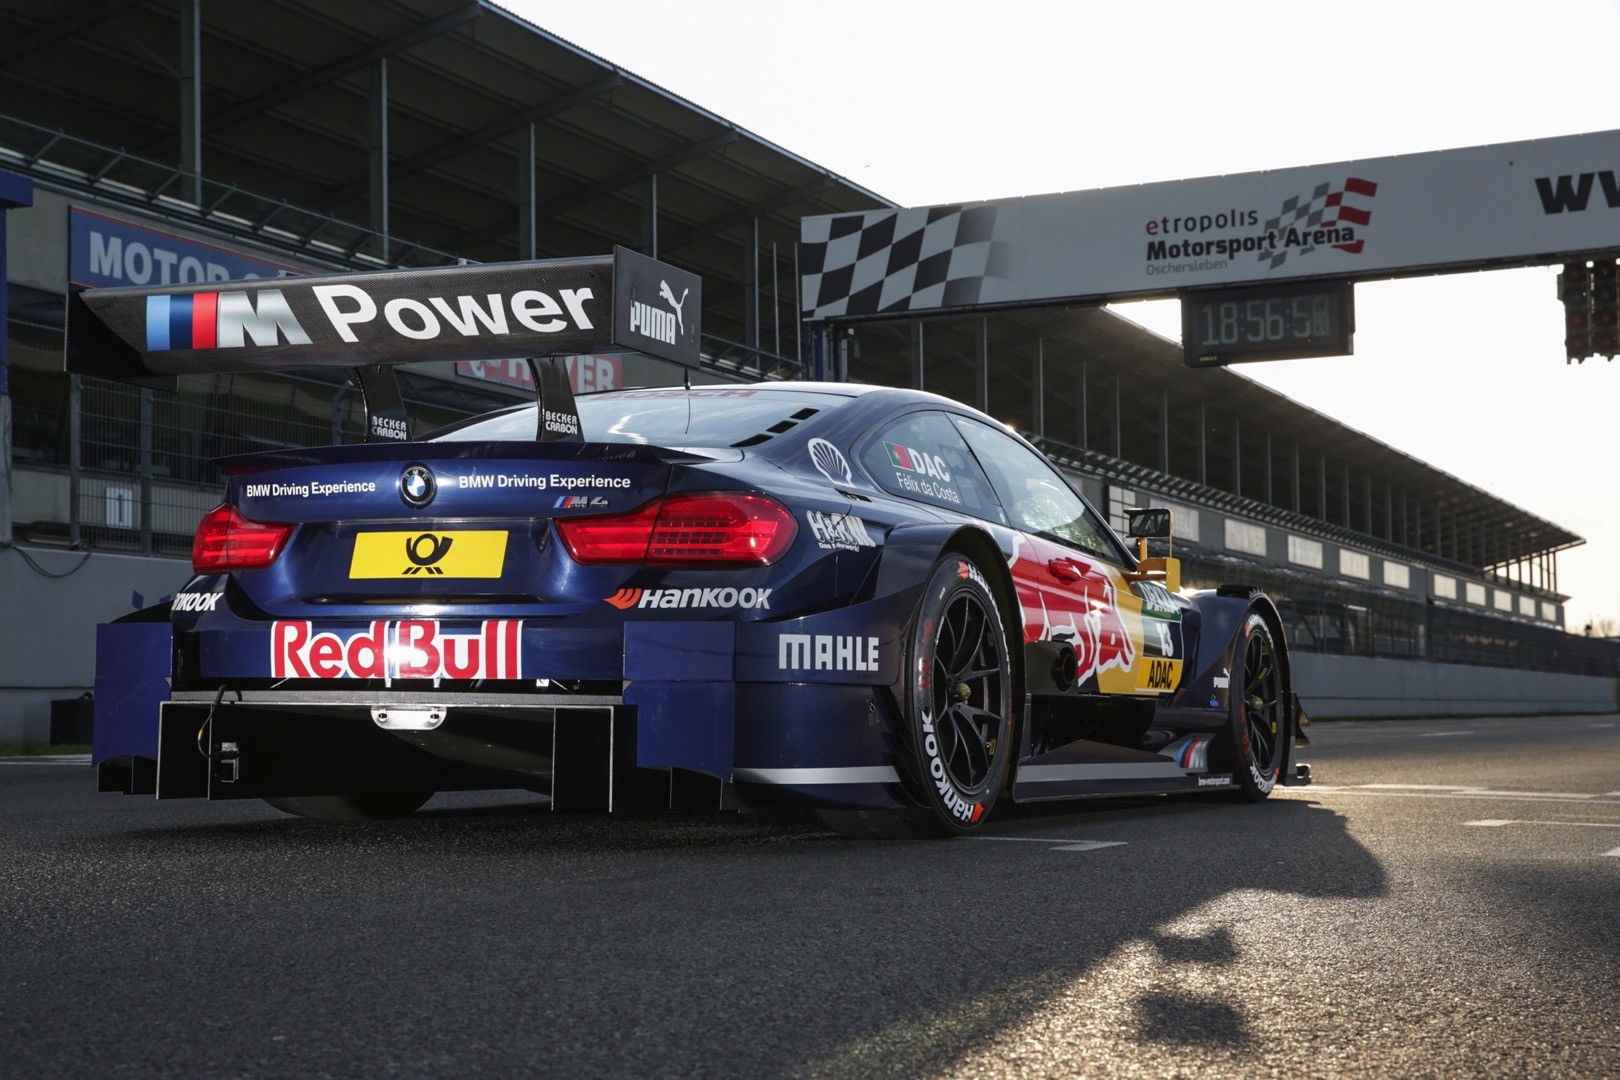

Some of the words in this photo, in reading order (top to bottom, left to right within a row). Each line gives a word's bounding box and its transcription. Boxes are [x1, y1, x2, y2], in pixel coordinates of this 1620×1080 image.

[1146, 210, 1258, 235] etropolis
[1147, 231, 1276, 261] Motorsport
[1284, 226, 1355, 248] Arena
[1146, 259, 1228, 276] Oschersleben
[312, 284, 594, 343] Power
[629, 300, 676, 345] PUMA
[372, 416, 407, 431] BECKER
[545, 411, 578, 425] BECKER
[545, 422, 578, 435] CARBON
[372, 424, 407, 440] CARBON
[906, 447, 951, 482] DAC
[246, 484, 271, 497] BMW
[272, 483, 309, 498] Driving
[311, 481, 376, 496] Experience
[458, 475, 494, 488] BMW
[497, 474, 547, 490] Driving
[550, 474, 631, 489] Experience
[921, 480, 933, 496] da
[932, 482, 960, 504] Costa
[271, 620, 389, 679] Red
[1156, 622, 1174, 657] 13
[778, 633, 880, 672] MAHLE
[1147, 660, 1174, 690] ADAC
